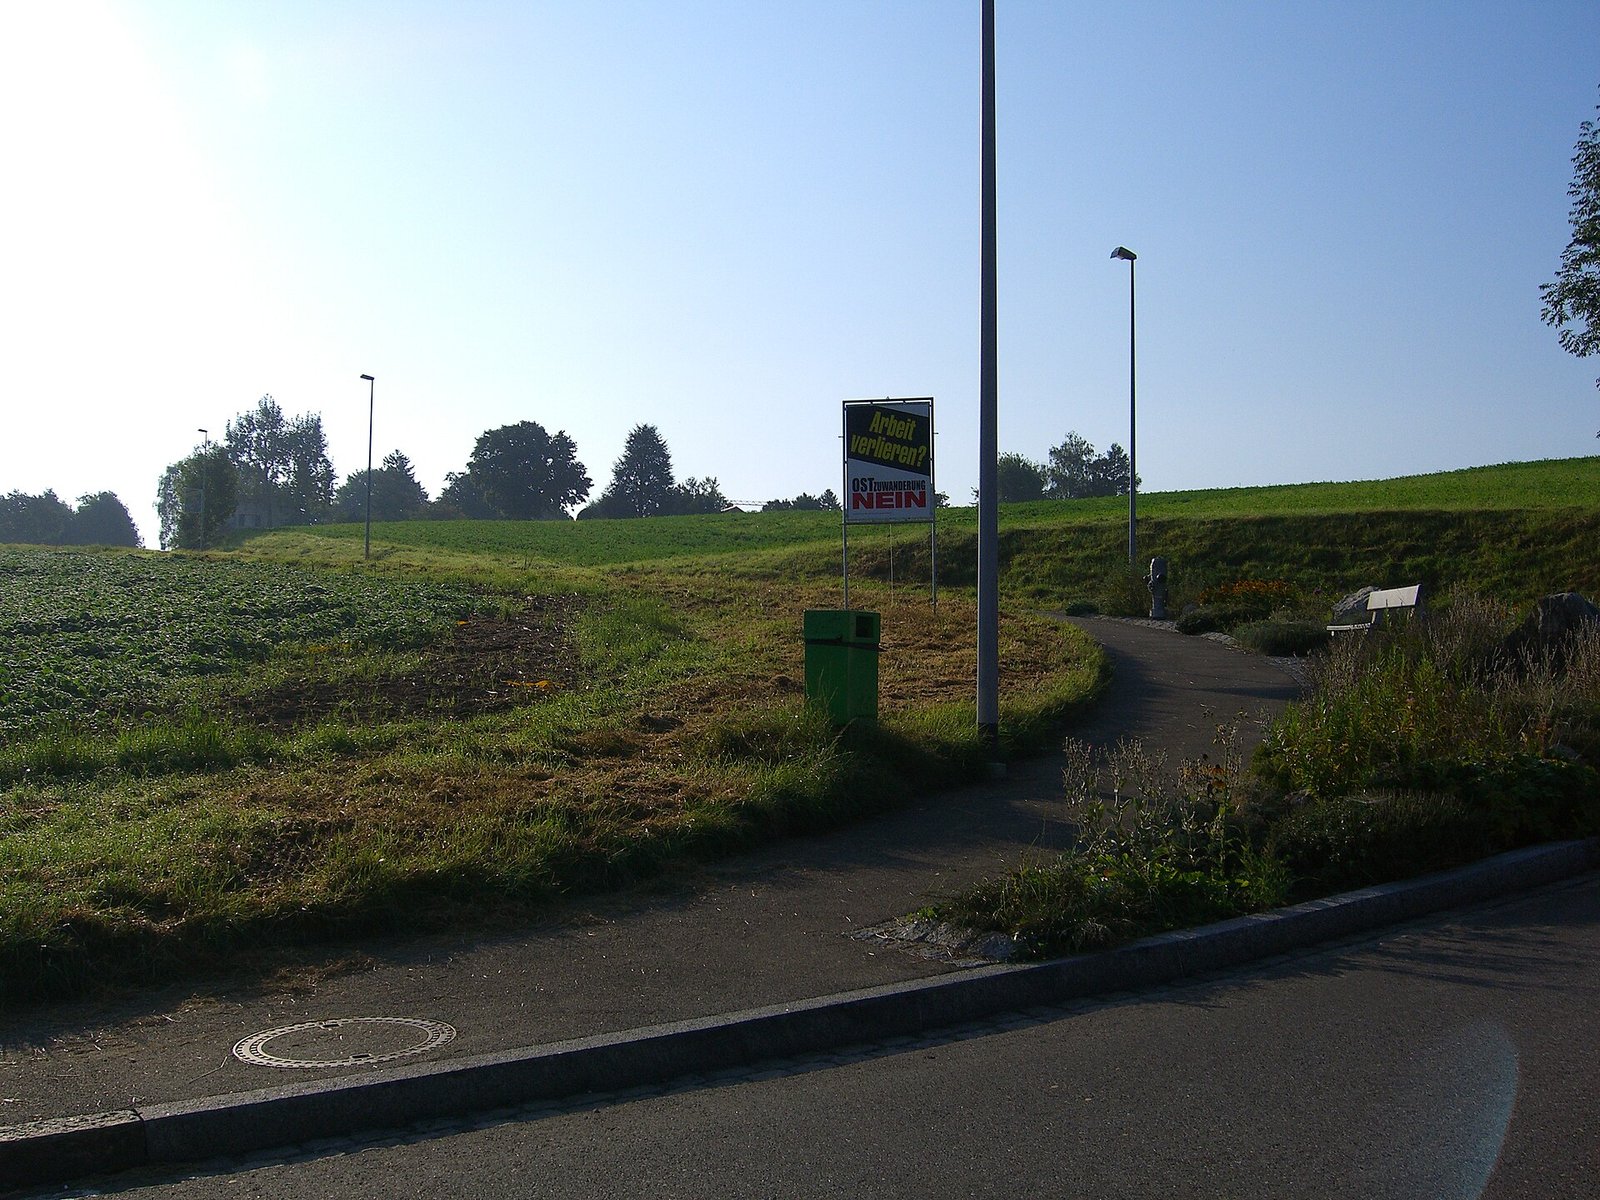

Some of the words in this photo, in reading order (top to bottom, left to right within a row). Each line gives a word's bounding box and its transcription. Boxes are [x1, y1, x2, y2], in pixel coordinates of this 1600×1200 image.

[869, 411, 917, 440] Arbeit
[851, 435, 926, 467] verlieren?
[852, 491, 926, 509] NEIN
